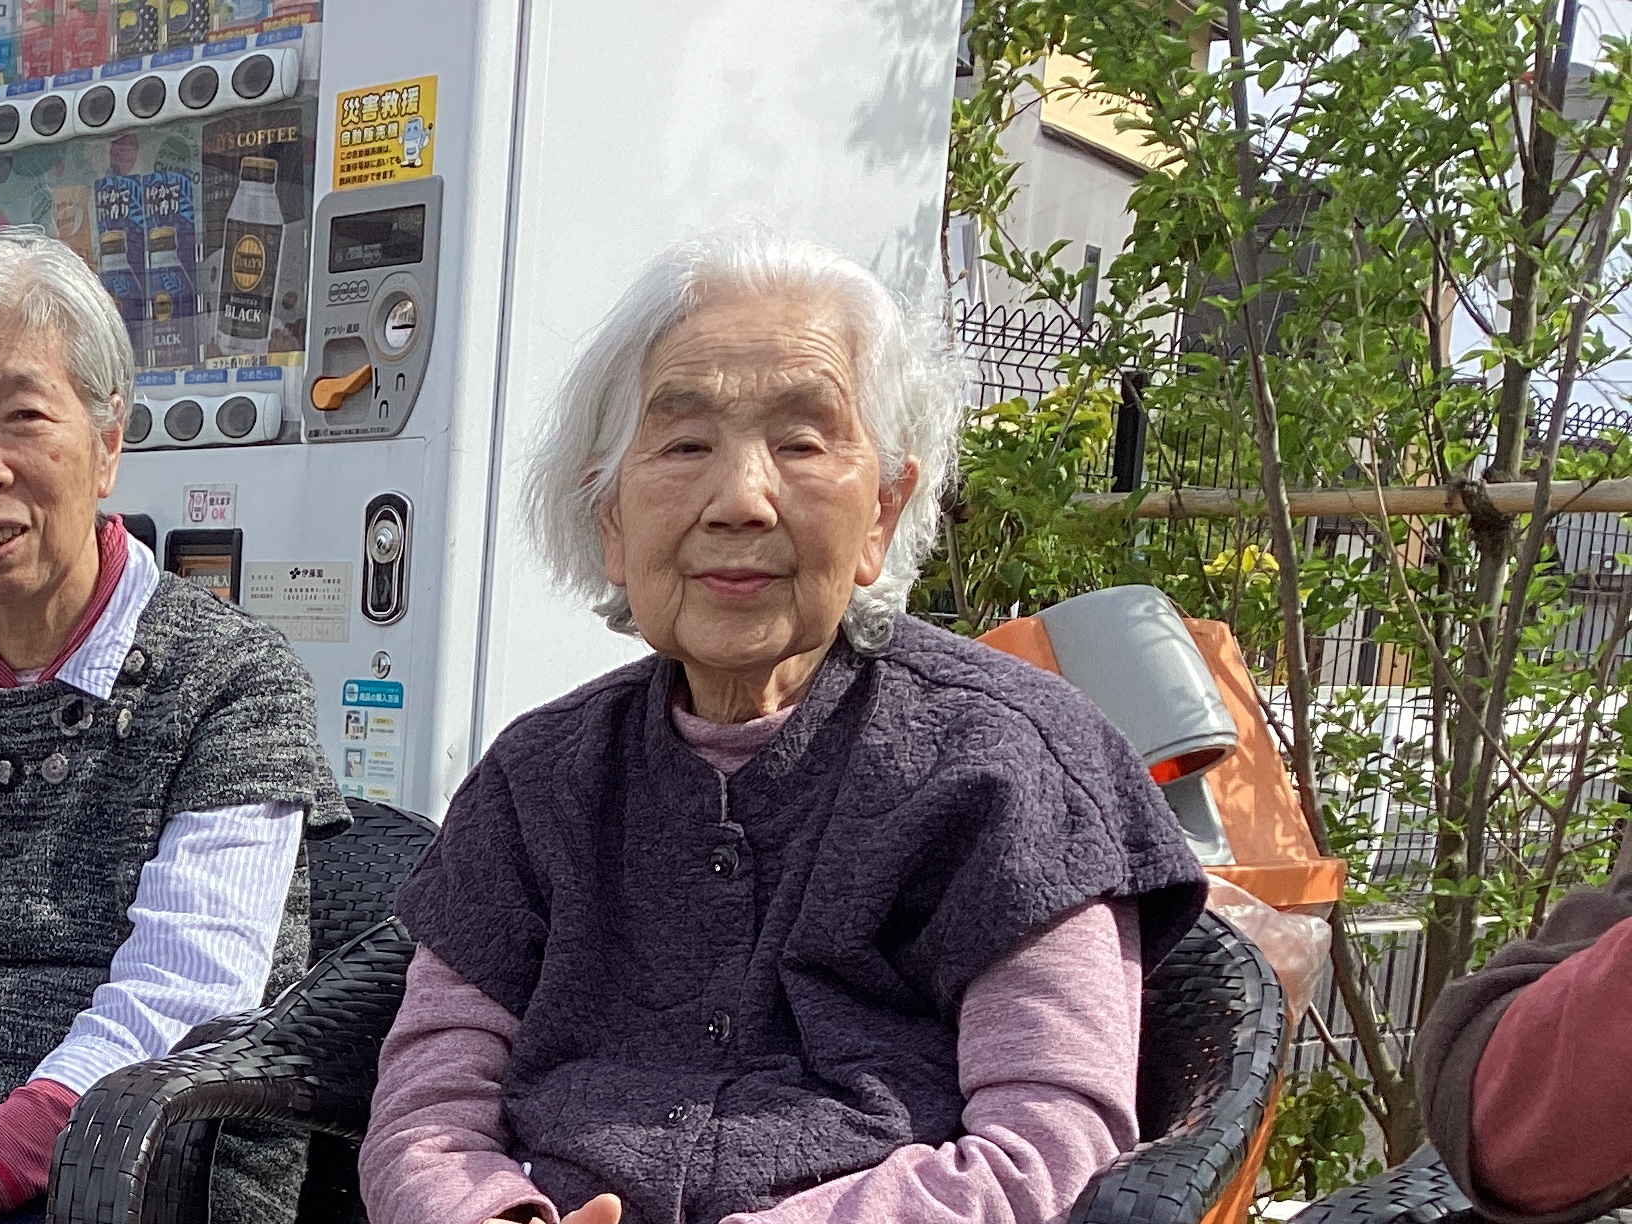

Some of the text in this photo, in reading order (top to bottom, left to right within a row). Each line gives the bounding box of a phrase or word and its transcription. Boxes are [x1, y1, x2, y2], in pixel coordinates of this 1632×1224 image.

[342, 85, 420, 126] 災害救援
[237, 126, 298, 147] COFFEE
[225, 304, 261, 323] BLACK
[212, 508, 226, 520] OK
[302, 568, 324, 578] 伊藤園
